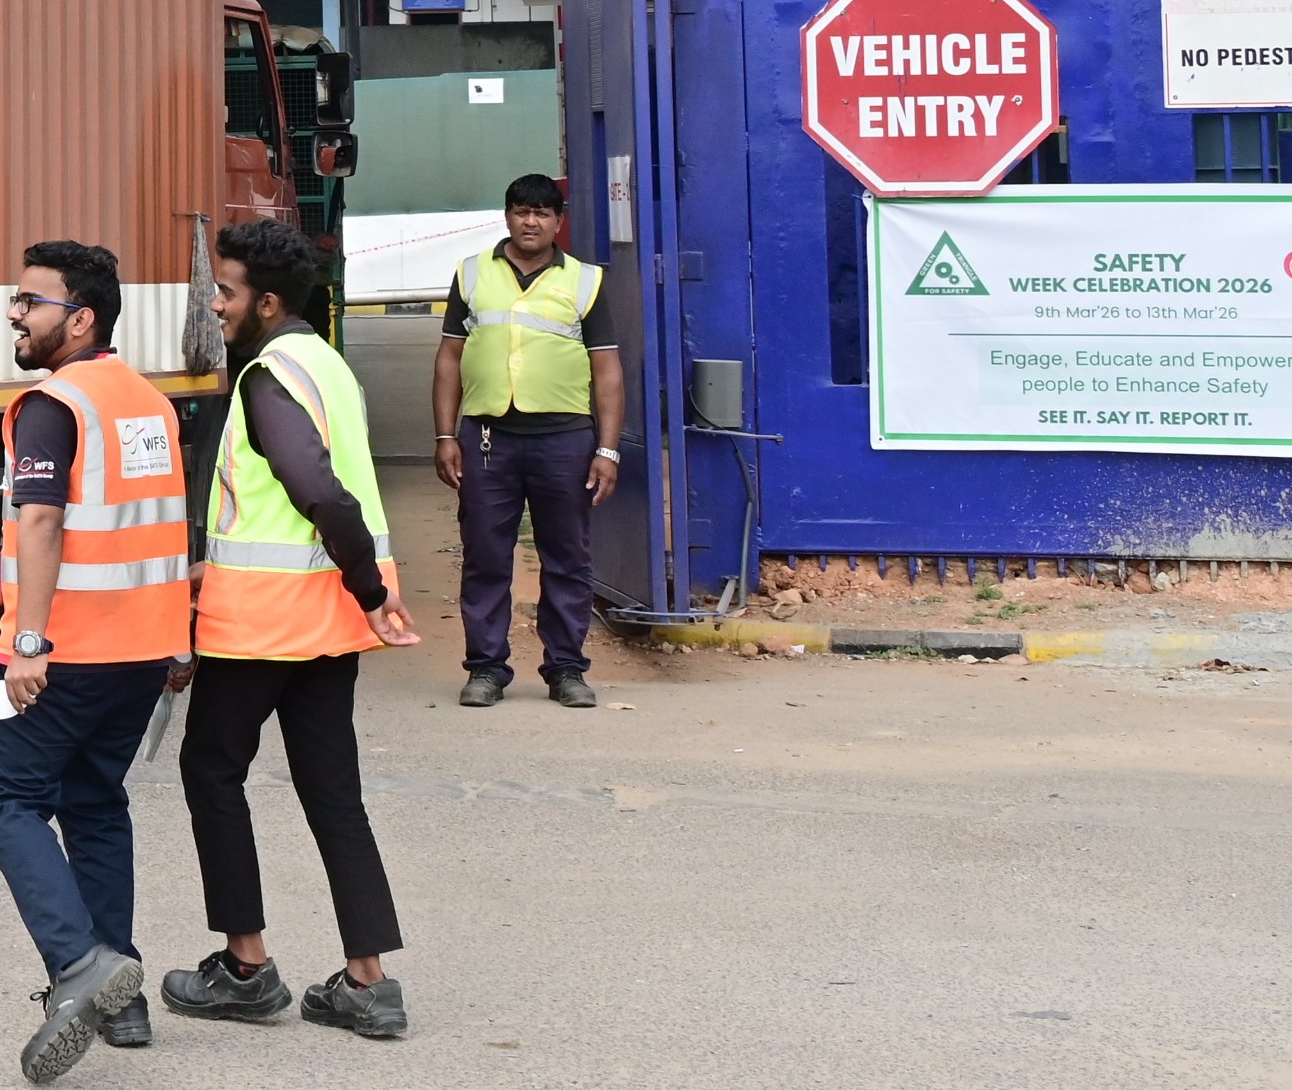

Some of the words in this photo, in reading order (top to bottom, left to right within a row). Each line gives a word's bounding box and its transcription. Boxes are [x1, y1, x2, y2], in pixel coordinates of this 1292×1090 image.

[829, 32, 1027, 77] VEHICLE
[1181, 49, 1209, 67] NO
[858, 95, 1005, 138] ENTRY
[919, 253, 936, 276] GREEN
[1093, 253, 1186, 273] SAFETY
[1009, 278, 1067, 293] WEEK
[1072, 278, 1211, 293] CELEBRATION
[1217, 278, 1273, 294] 2026
[1034, 306, 1060, 318] 9th
[1066, 305, 1120, 319] Mar'26
[1125, 307, 1140, 319] to
[1146, 306, 1177, 319] 13th
[1183, 306, 1238, 319] Mar'26
[990, 350, 1068, 370] Engage,
[1076, 351, 1153, 367] Educate
[1159, 352, 1195, 367] and
[1022, 377, 1085, 395] people
[1092, 379, 1109, 392] to
[1116, 377, 1200, 393] Enhance
[1207, 378, 1269, 397] Safety
[1038, 410, 1068, 424] SEE
[1073, 411, 1092, 424] IT.
[1096, 411, 1132, 425] SAY
[1135, 412, 1154, 425] IT.
[1160, 412, 1230, 426] REPORT
[1233, 413, 1253, 426] IT.
[142, 435, 167, 452] WFS
[34, 461, 55, 471] WFS
